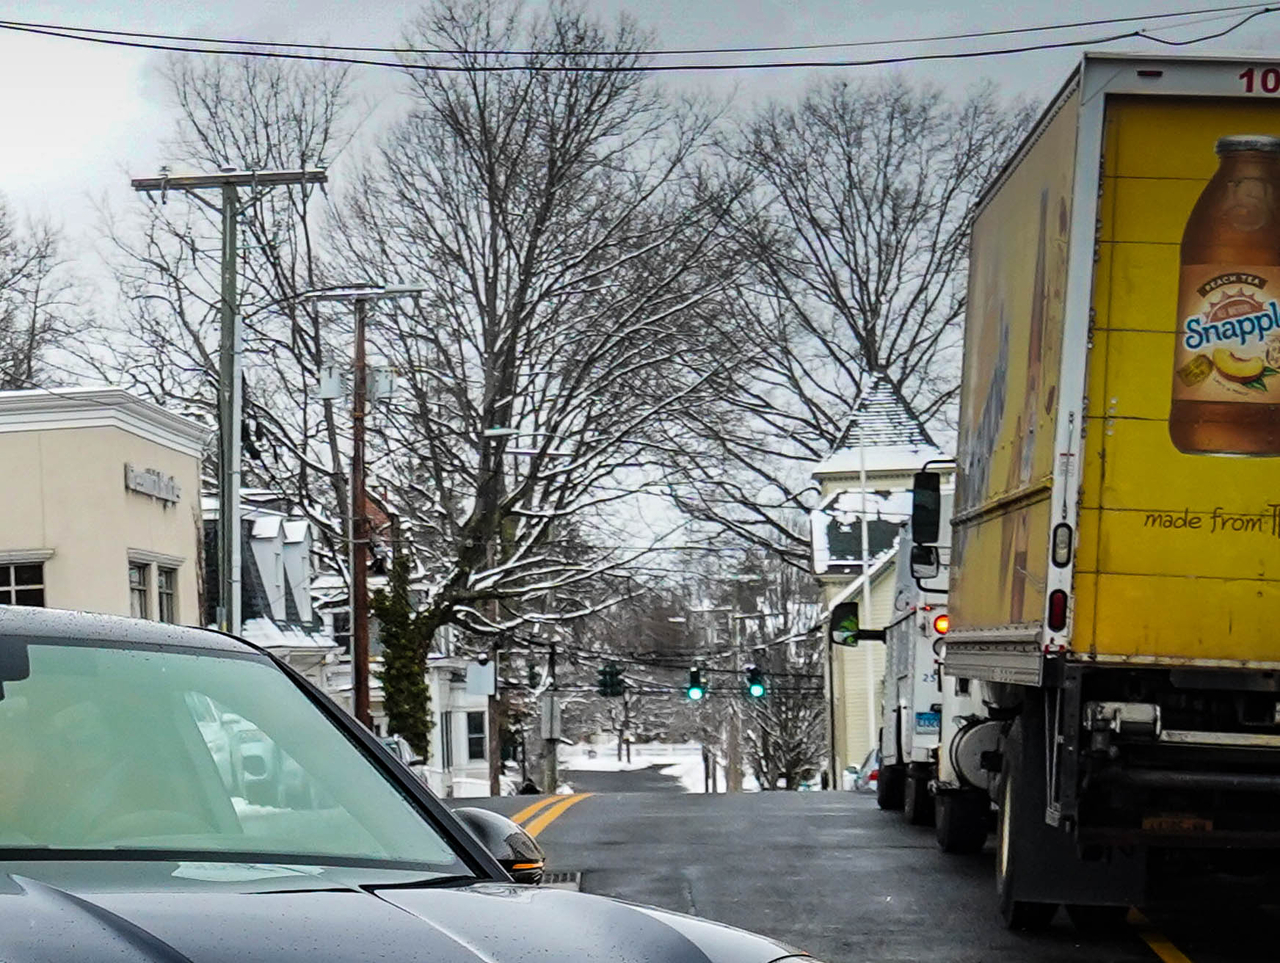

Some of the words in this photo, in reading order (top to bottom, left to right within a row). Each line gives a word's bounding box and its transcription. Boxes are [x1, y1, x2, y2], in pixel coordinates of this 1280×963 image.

[1205, 275, 1237, 291] PEACH
[1241, 275, 1260, 285] TEA
[1185, 301, 1280, 349] Snappl
[1144, 507, 1202, 529] made
[1210, 506, 1262, 534] from
